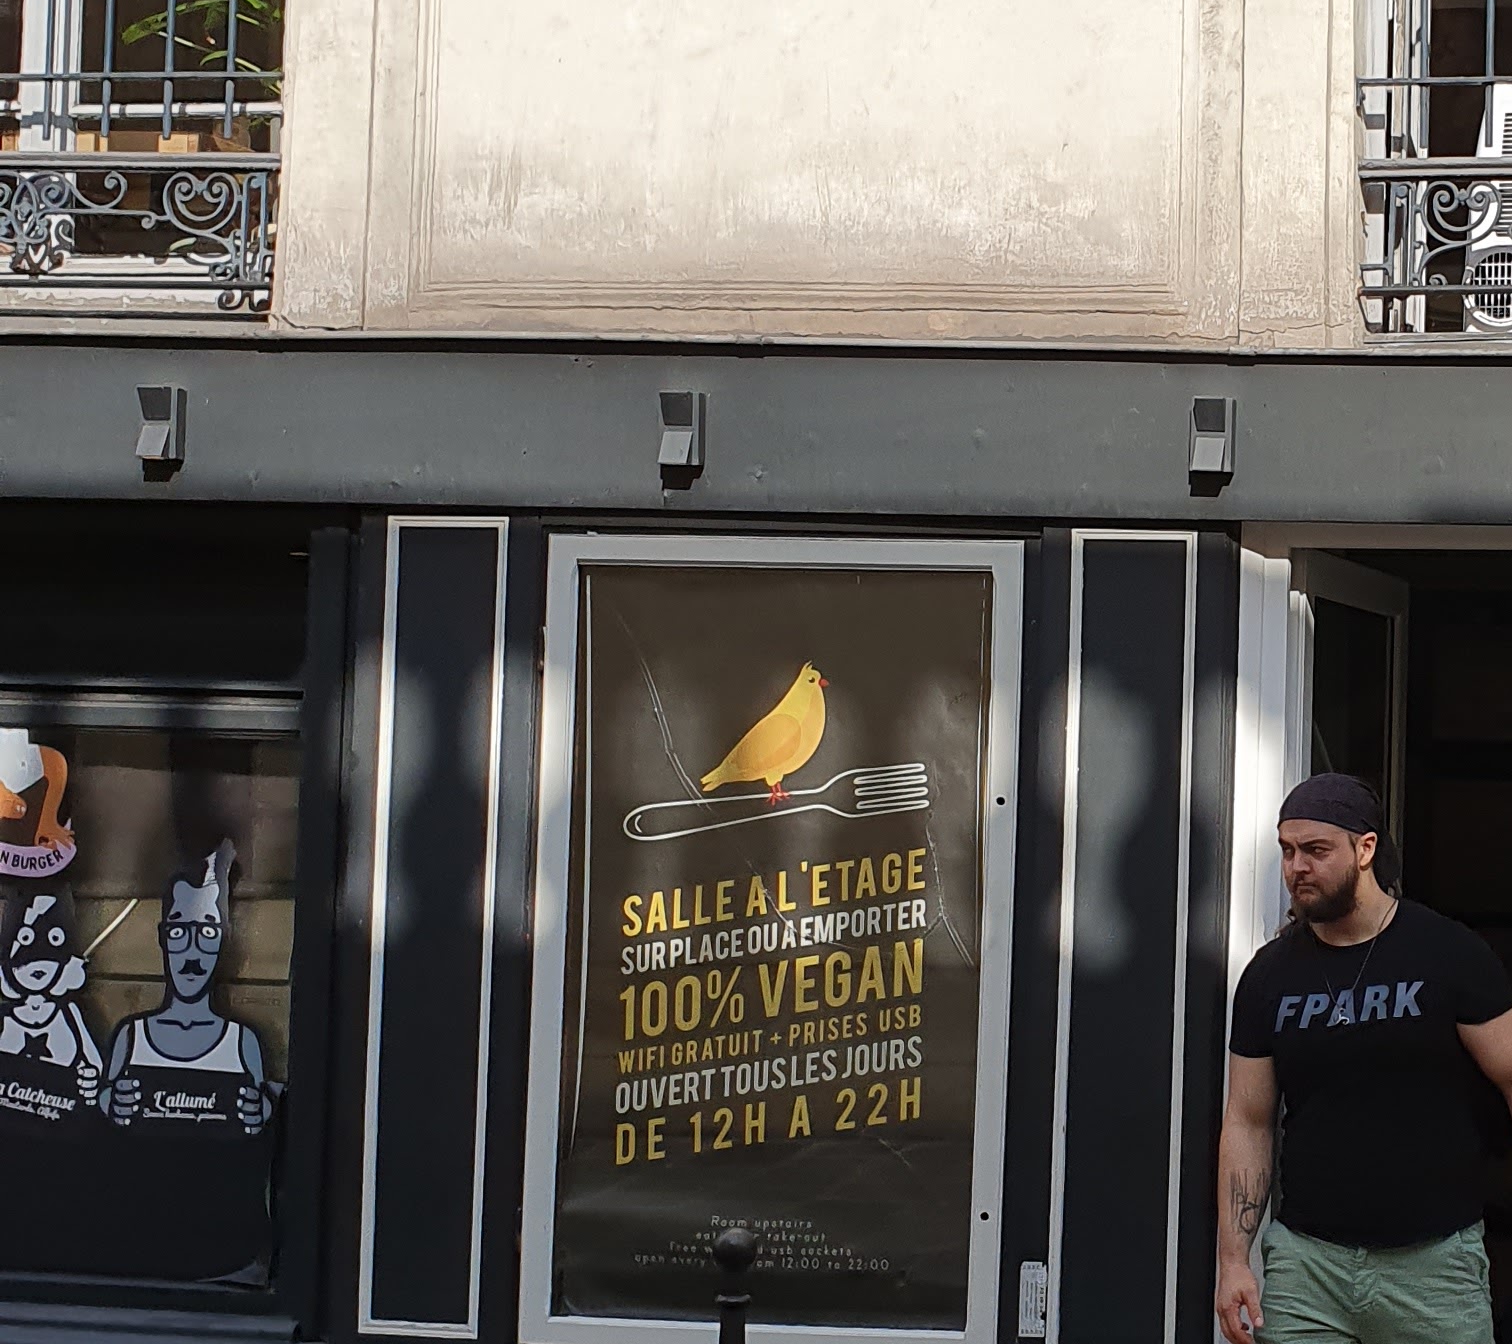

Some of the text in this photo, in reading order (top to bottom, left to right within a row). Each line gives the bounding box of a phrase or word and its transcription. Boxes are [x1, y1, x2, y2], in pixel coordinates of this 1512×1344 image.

[11, 849, 64, 871] BURGER
[622, 847, 927, 937] SALLE A L'ETAGE
[620, 898, 927, 975] SUR PLACE OU A EMPORTER
[619, 937, 925, 1041] 100% VEGAN
[1274, 981, 1424, 1032] FPARK
[615, 1035, 923, 1115] OUVERT TOUS LES JOURS
[617, 1045, 665, 1074] WIFI
[671, 1029, 763, 1067] GRATUIT
[789, 1012, 868, 1047] PRISES
[879, 1004, 922, 1033] USB
[153, 1090, 217, 1112] L'allumé
[615, 1076, 921, 1166] DE 12H A 22H
[711, 1215, 748, 1228] Room
